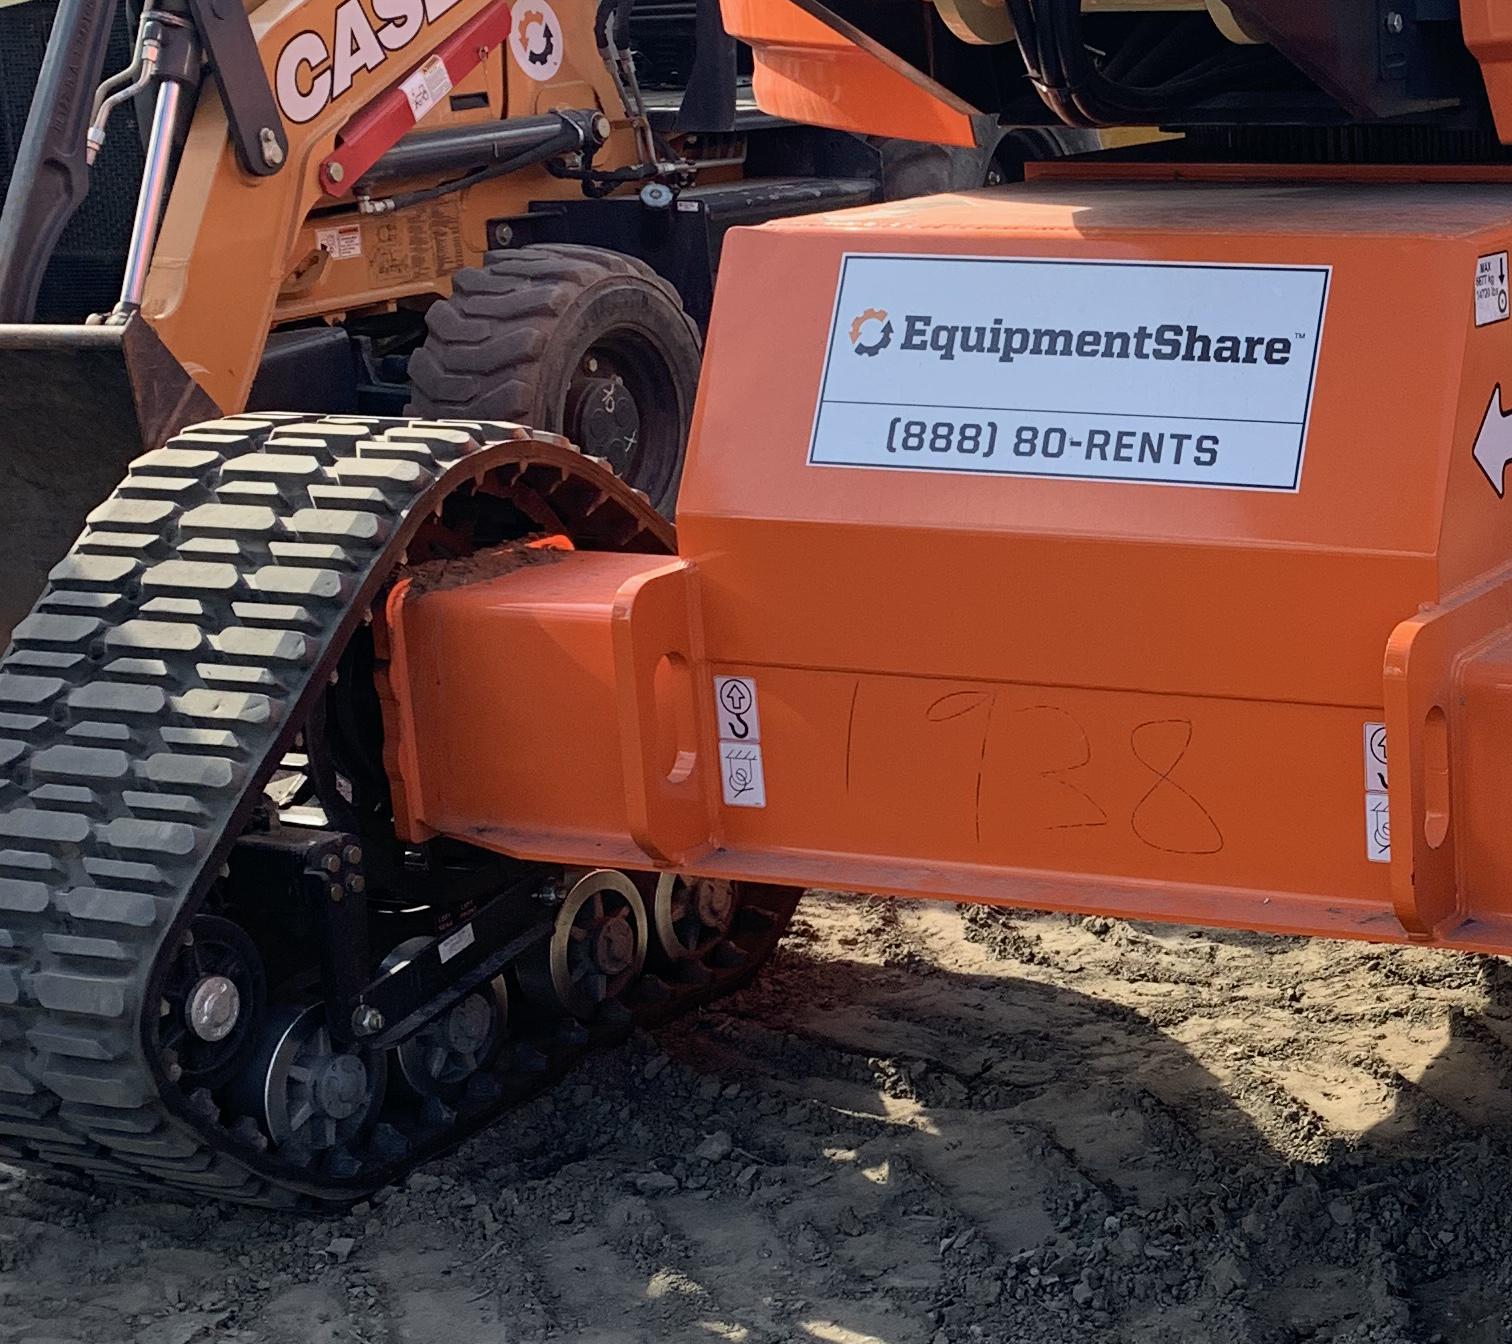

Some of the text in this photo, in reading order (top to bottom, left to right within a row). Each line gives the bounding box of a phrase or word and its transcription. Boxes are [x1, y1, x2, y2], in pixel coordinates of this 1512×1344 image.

[1480, 262, 1491, 273] MAX
[899, 314, 1292, 366] EquipmentShare
[886, 417, 1220, 467] (888) 80-RENTS
